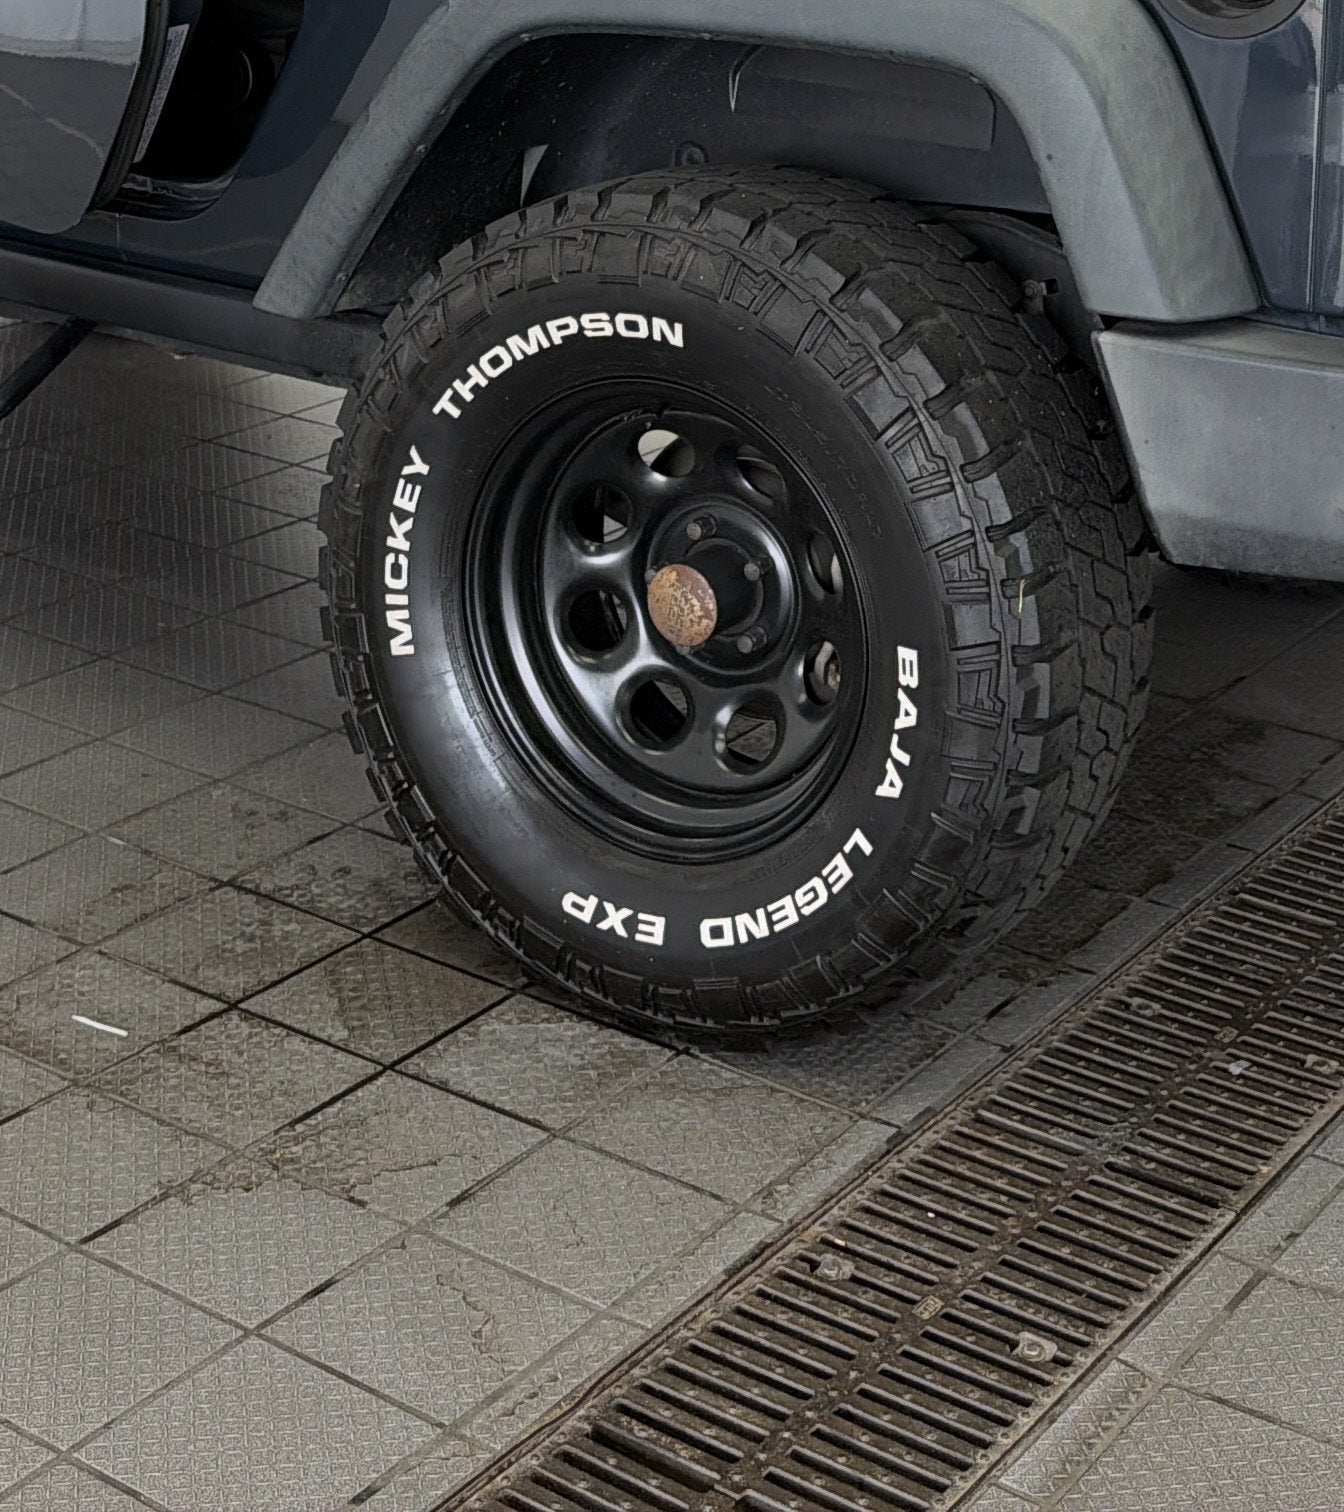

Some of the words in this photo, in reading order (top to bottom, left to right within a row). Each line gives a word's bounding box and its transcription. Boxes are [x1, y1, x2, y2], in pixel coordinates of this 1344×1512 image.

[384, 444, 431, 656] MICKEY
[431, 311, 685, 419] THOMPSON
[874, 645, 919, 799] BAJA
[561, 891, 666, 947] EXP
[699, 827, 874, 949] LEGEND
